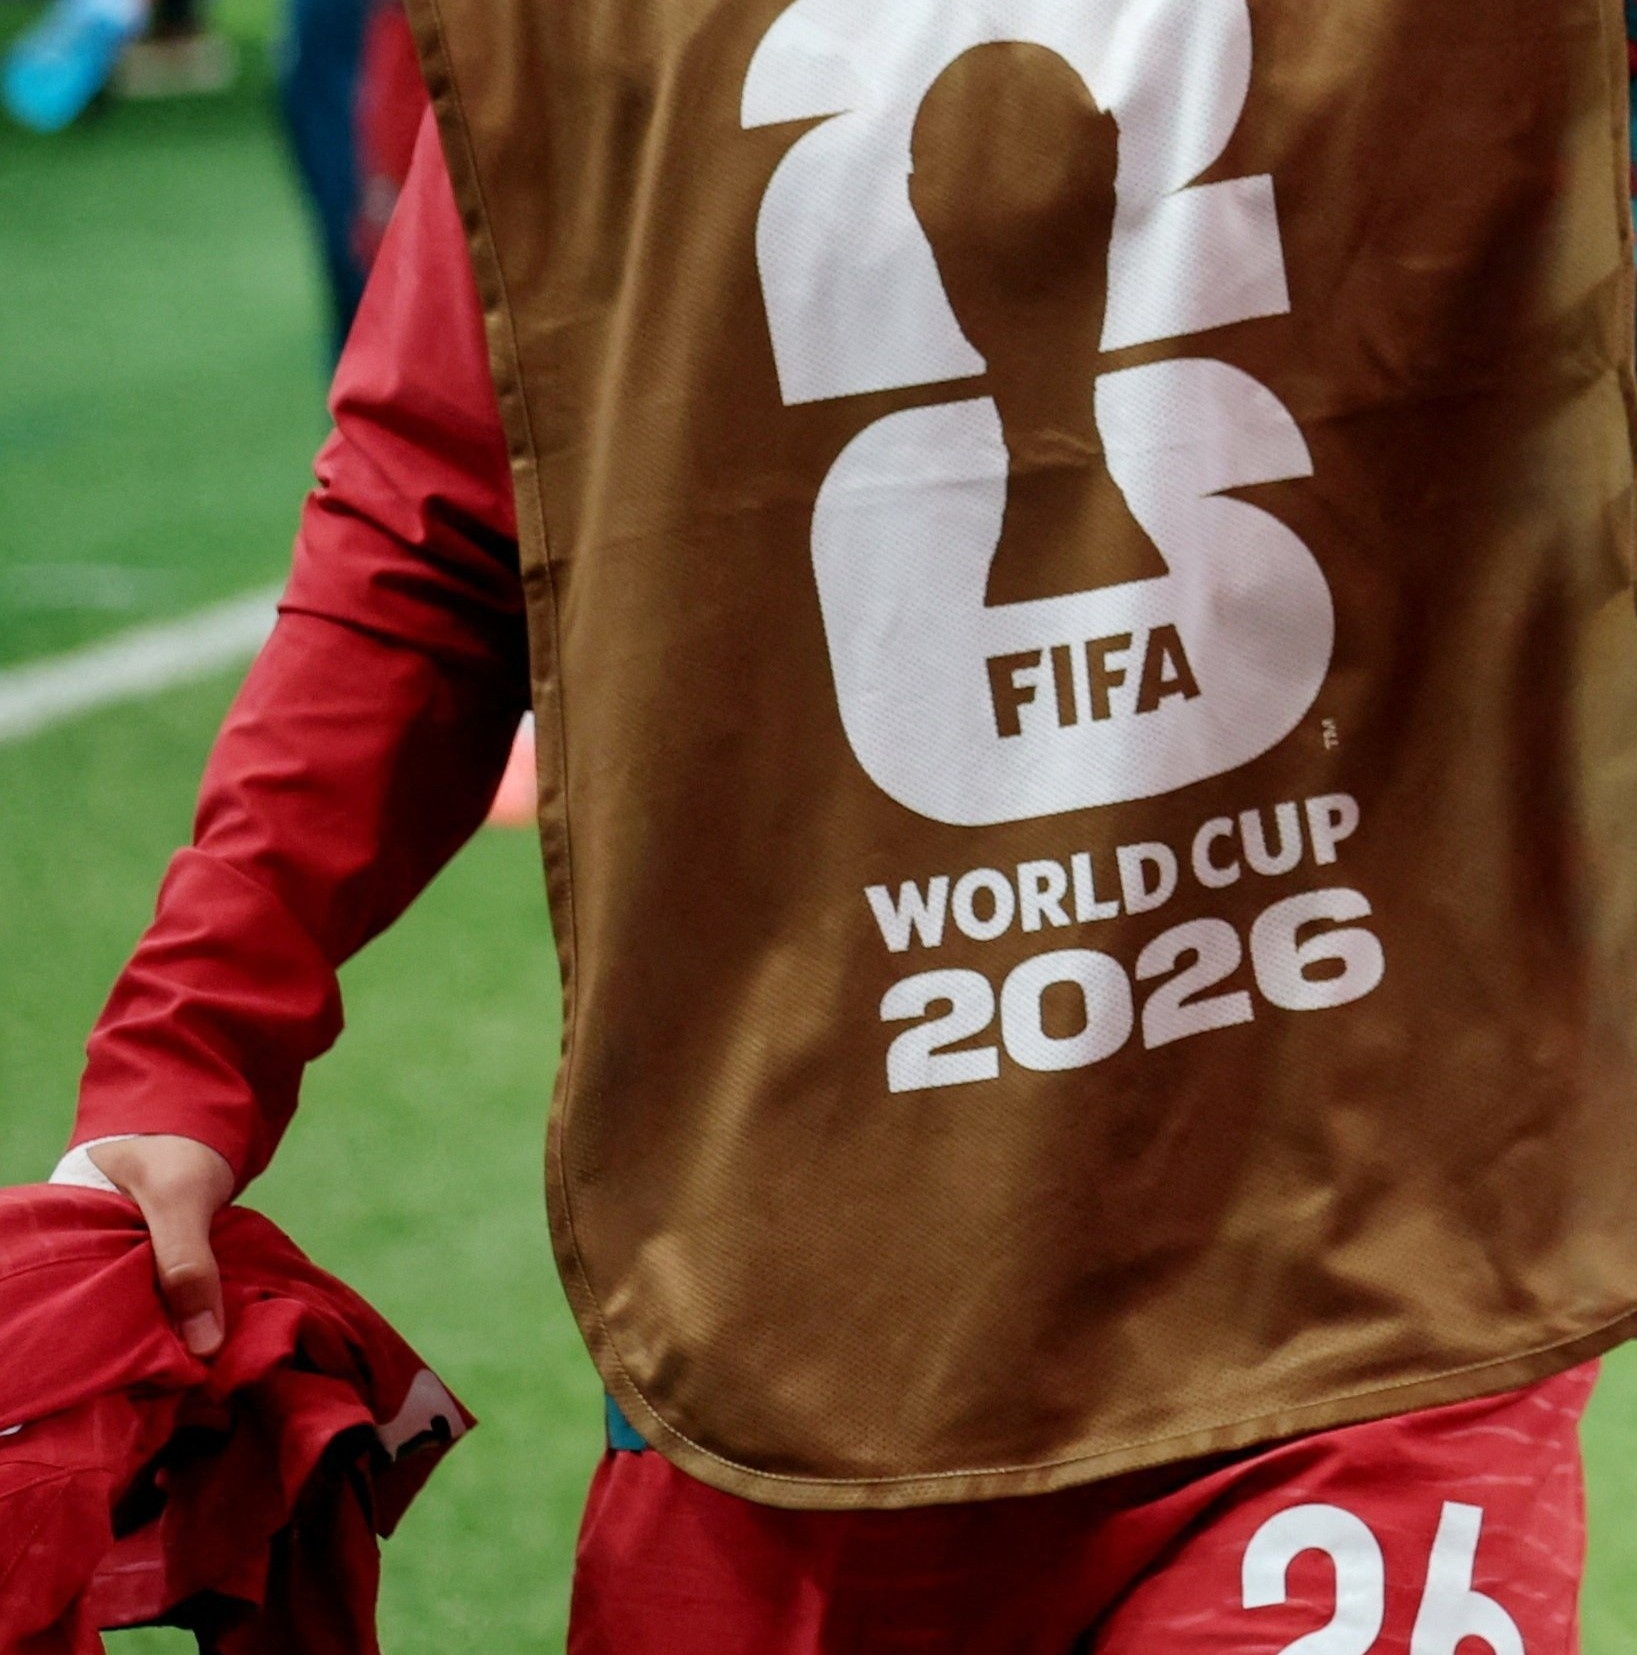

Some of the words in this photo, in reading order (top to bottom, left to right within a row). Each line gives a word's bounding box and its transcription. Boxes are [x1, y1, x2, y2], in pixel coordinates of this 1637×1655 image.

[985, 623, 1202, 739] FIFA
[863, 841, 1179, 952] WORLD
[1191, 792, 1361, 889] CUP
[879, 887, 1386, 1093] 2026
[1241, 1500, 1526, 1655] 26
